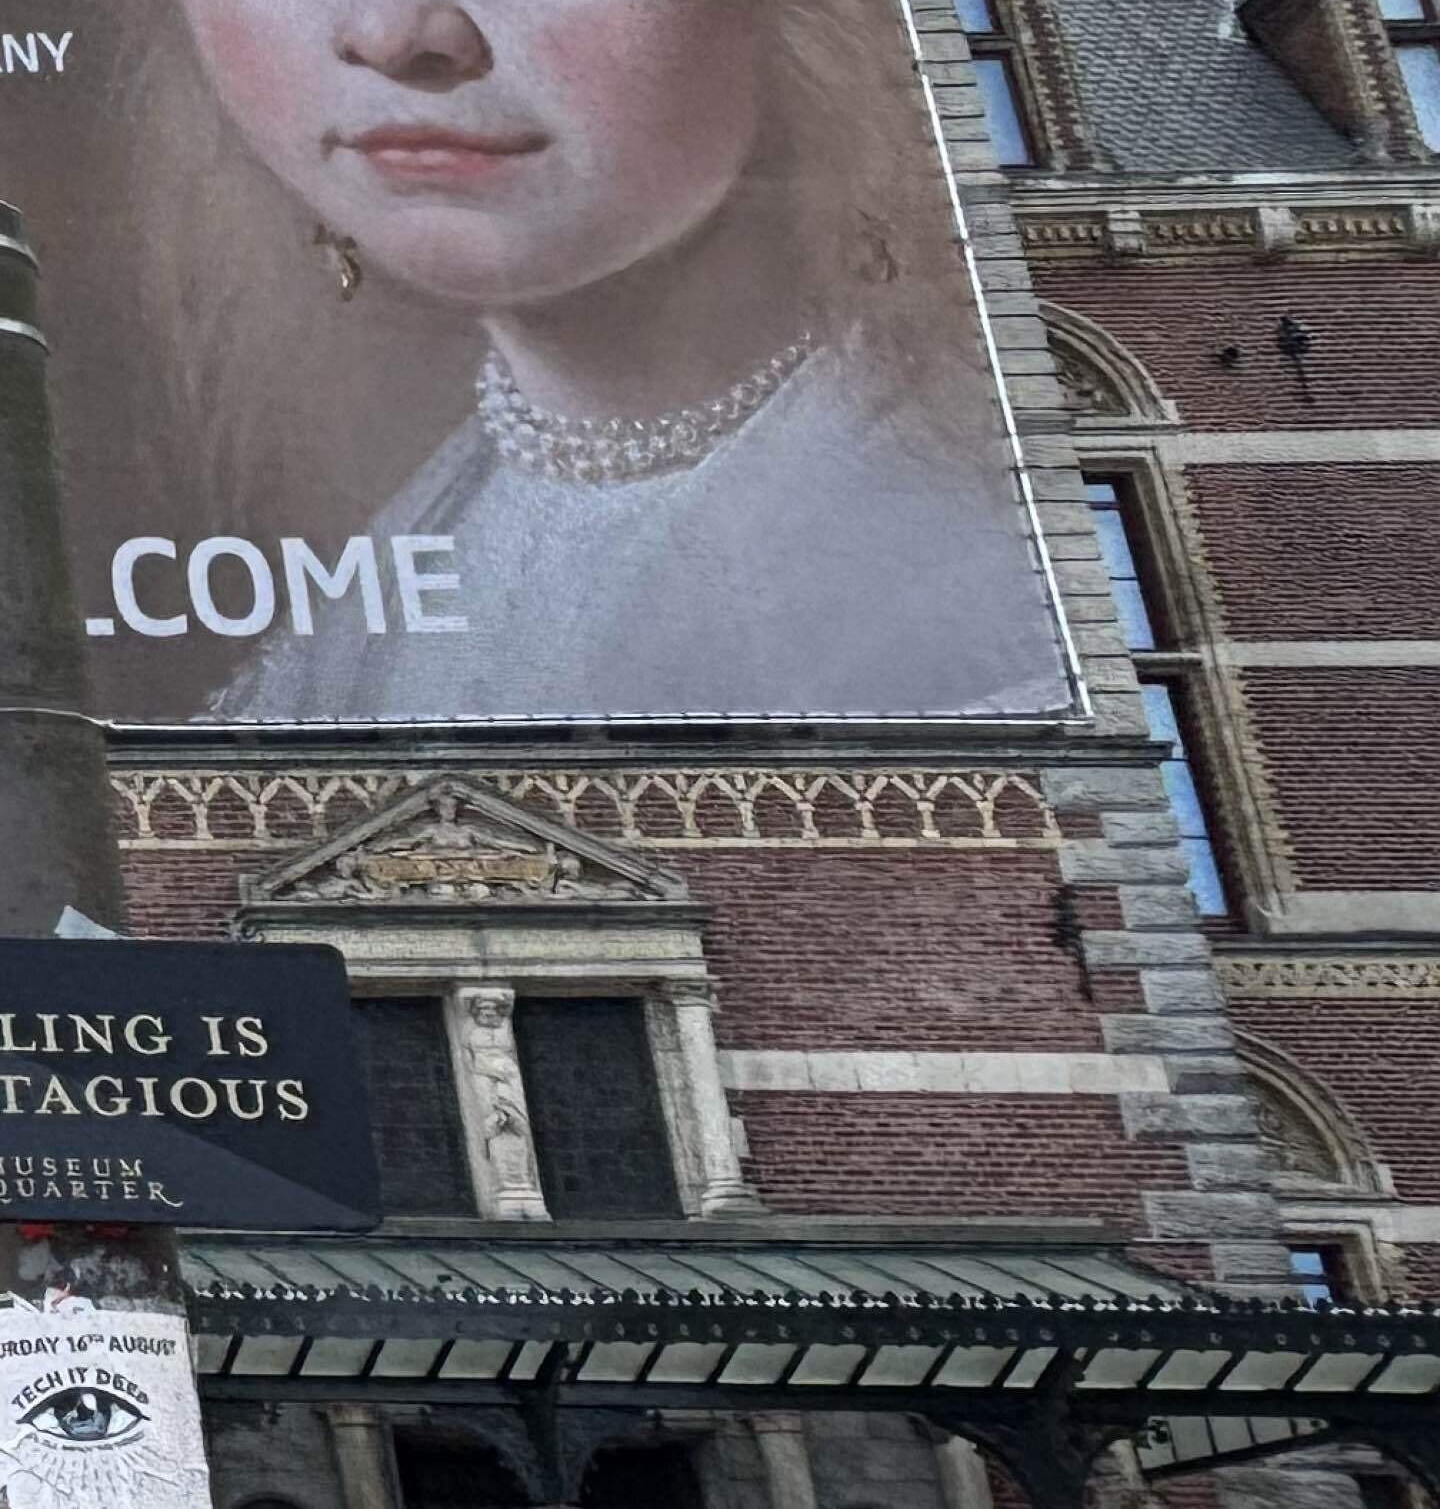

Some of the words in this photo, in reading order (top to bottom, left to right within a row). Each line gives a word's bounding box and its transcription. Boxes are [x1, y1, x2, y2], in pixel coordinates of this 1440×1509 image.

[201, 1015, 269, 1057] IS
[109, 1335, 177, 1356] AUGUST
[11, 1370, 64, 1410] TECH
[68, 1366, 89, 1385] IT
